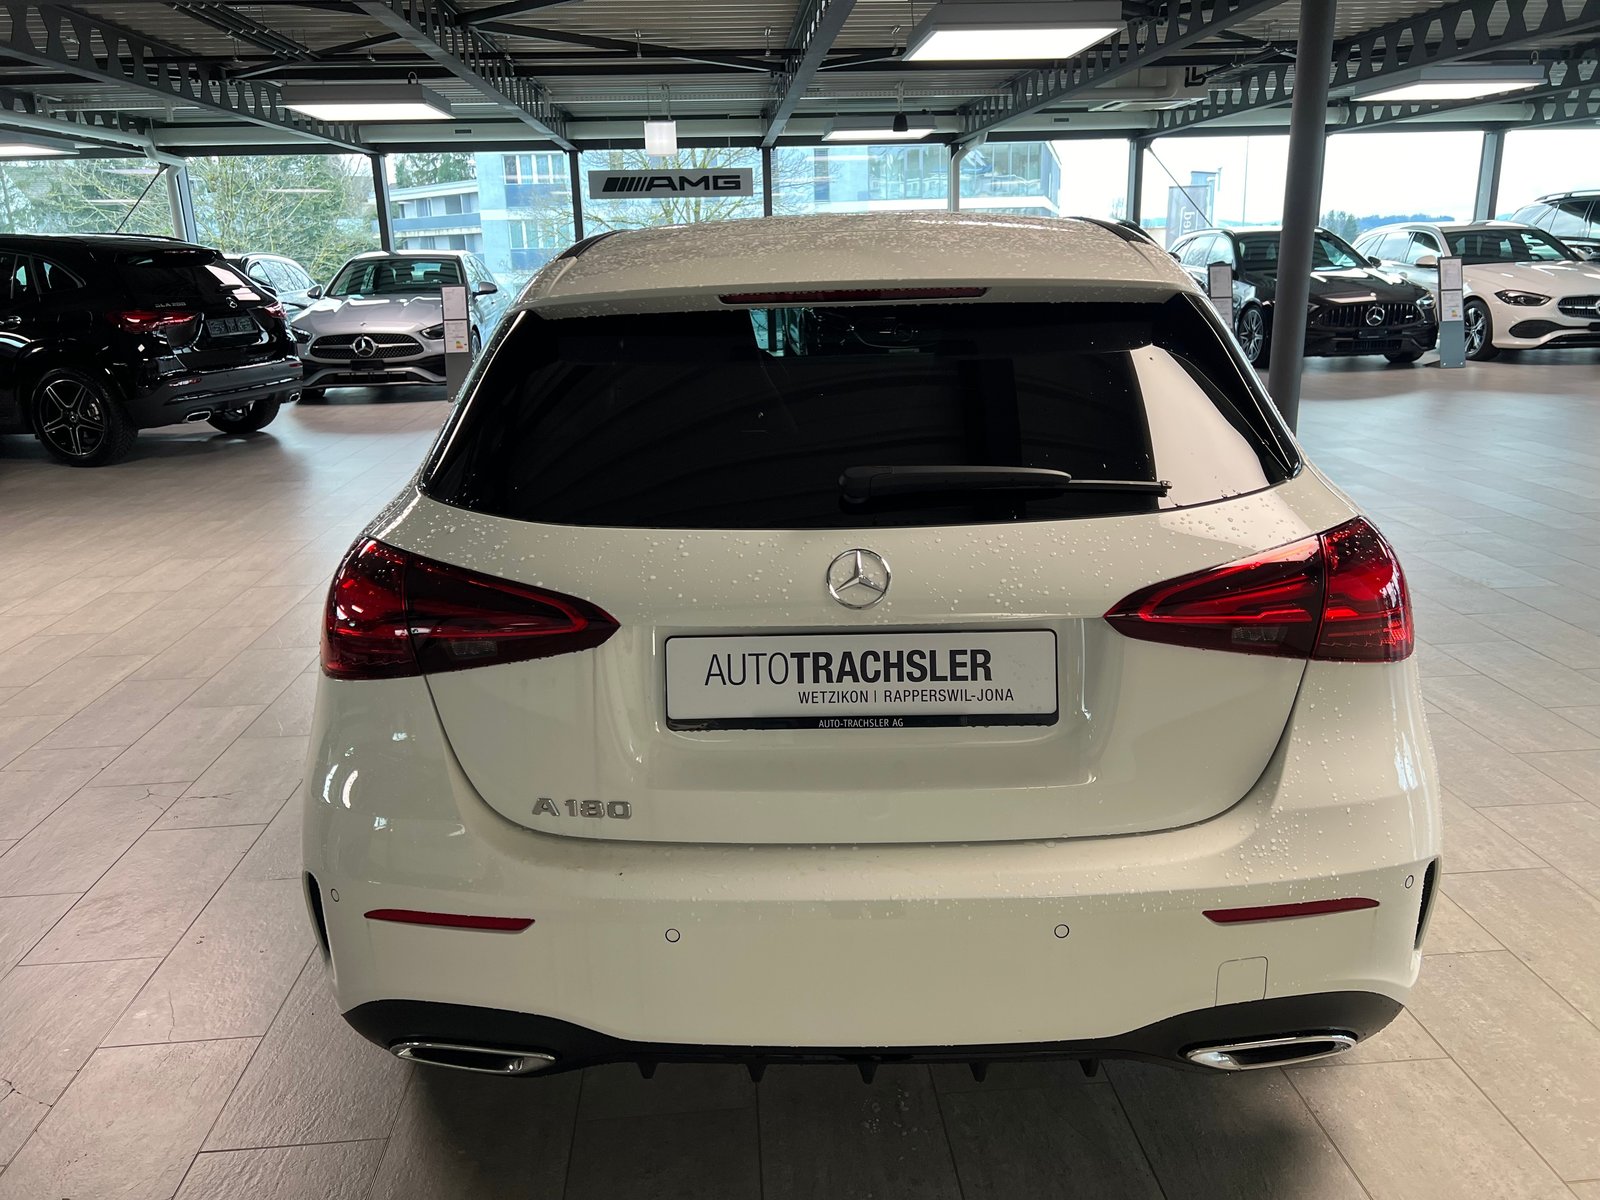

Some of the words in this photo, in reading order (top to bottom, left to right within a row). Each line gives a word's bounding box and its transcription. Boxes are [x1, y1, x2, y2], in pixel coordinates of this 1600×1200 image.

[645, 175, 741, 191] AMG
[705, 649, 992, 685] AUTOTRACHSLER
[798, 690, 868, 704] WETZIKON
[884, 688, 1014, 702] RAPPERSWIL-JONA
[818, 719, 889, 728] AUTO-TRACHSLER
[892, 718, 904, 727] AG
[532, 797, 560, 816] A
[564, 799, 632, 819] 180
